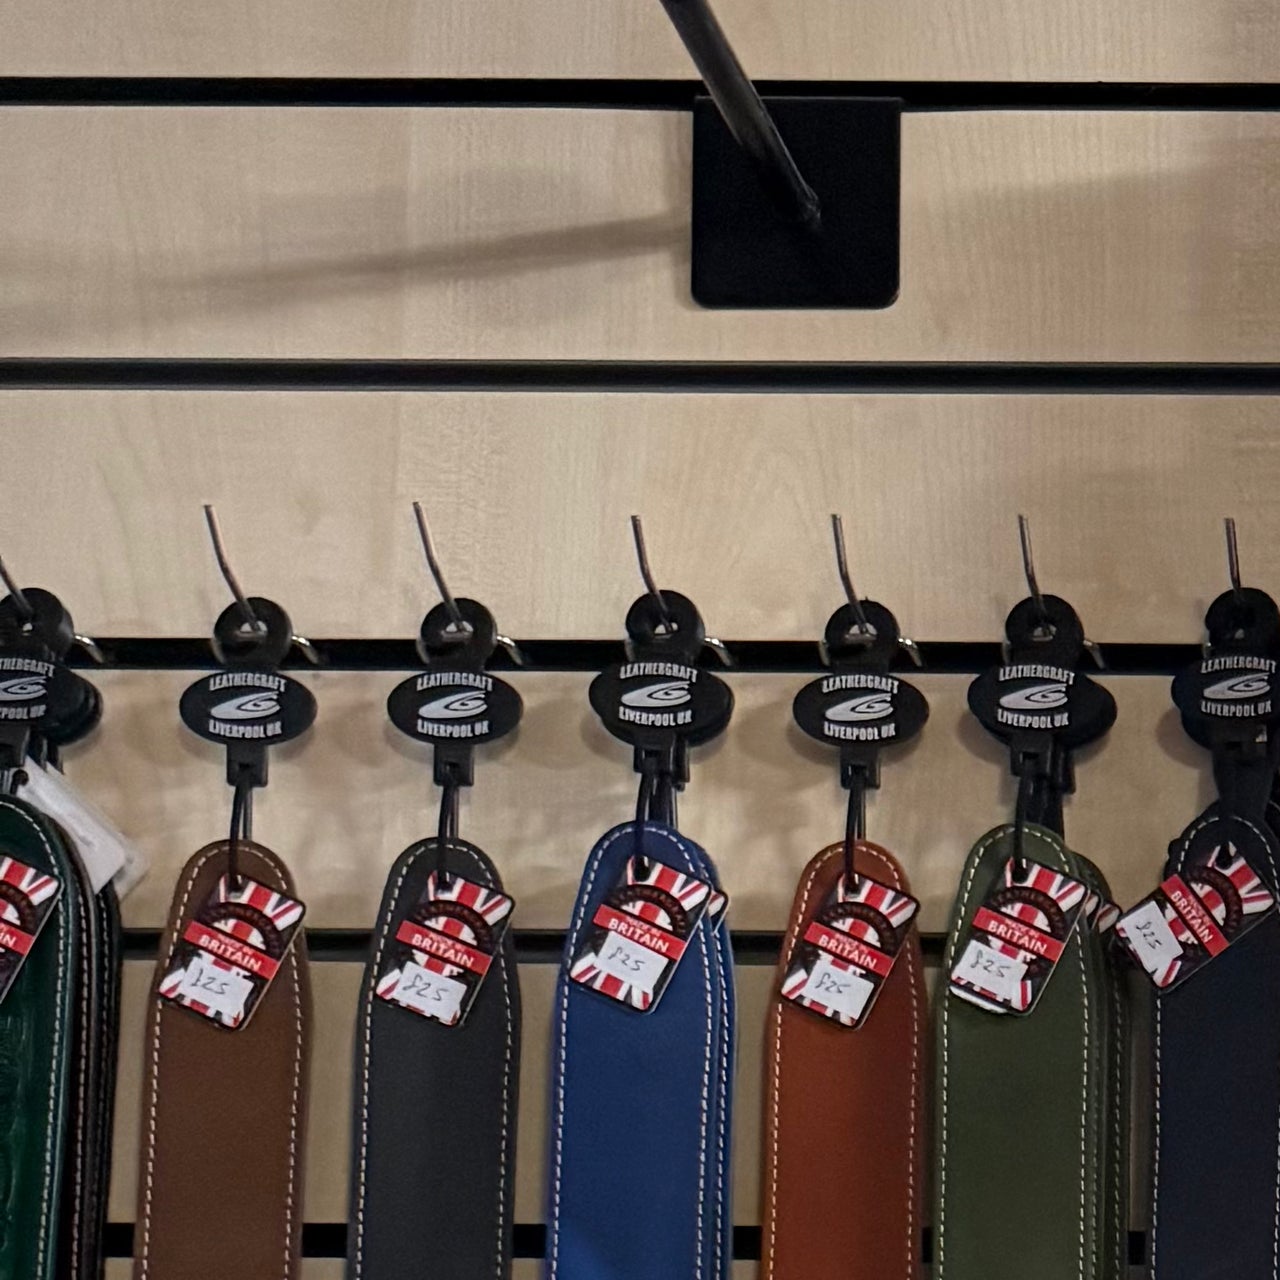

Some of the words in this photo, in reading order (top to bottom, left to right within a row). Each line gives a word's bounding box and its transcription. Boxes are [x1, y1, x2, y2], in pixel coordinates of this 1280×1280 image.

[619, 706, 676, 727] LIVERPOOL
[676, 709, 692, 724] UK
[997, 709, 1053, 728] LIVERPOOL
[1054, 712, 1069, 726] UK
[1201, 700, 1256, 717] LIVERPOOL
[1257, 700, 1271, 715] UK
[209, 720, 264, 738] LIVERPOOL
[265, 721, 281, 735] UK
[417, 719, 473, 738] LIVERPOOL
[474, 720, 489, 735] UK
[824, 721, 880, 741] LIVERPOOL
[880, 723, 896, 738] UK
[1171, 890, 1214, 943] BRITAIN
[608, 918, 669, 952] BRITAIN
[988, 920, 1047, 954] BRITAIN
[198, 934, 262, 971] BRITAIN
[411, 934, 474, 967] BRITAIN
[819, 935, 877, 968] BRITAIN
